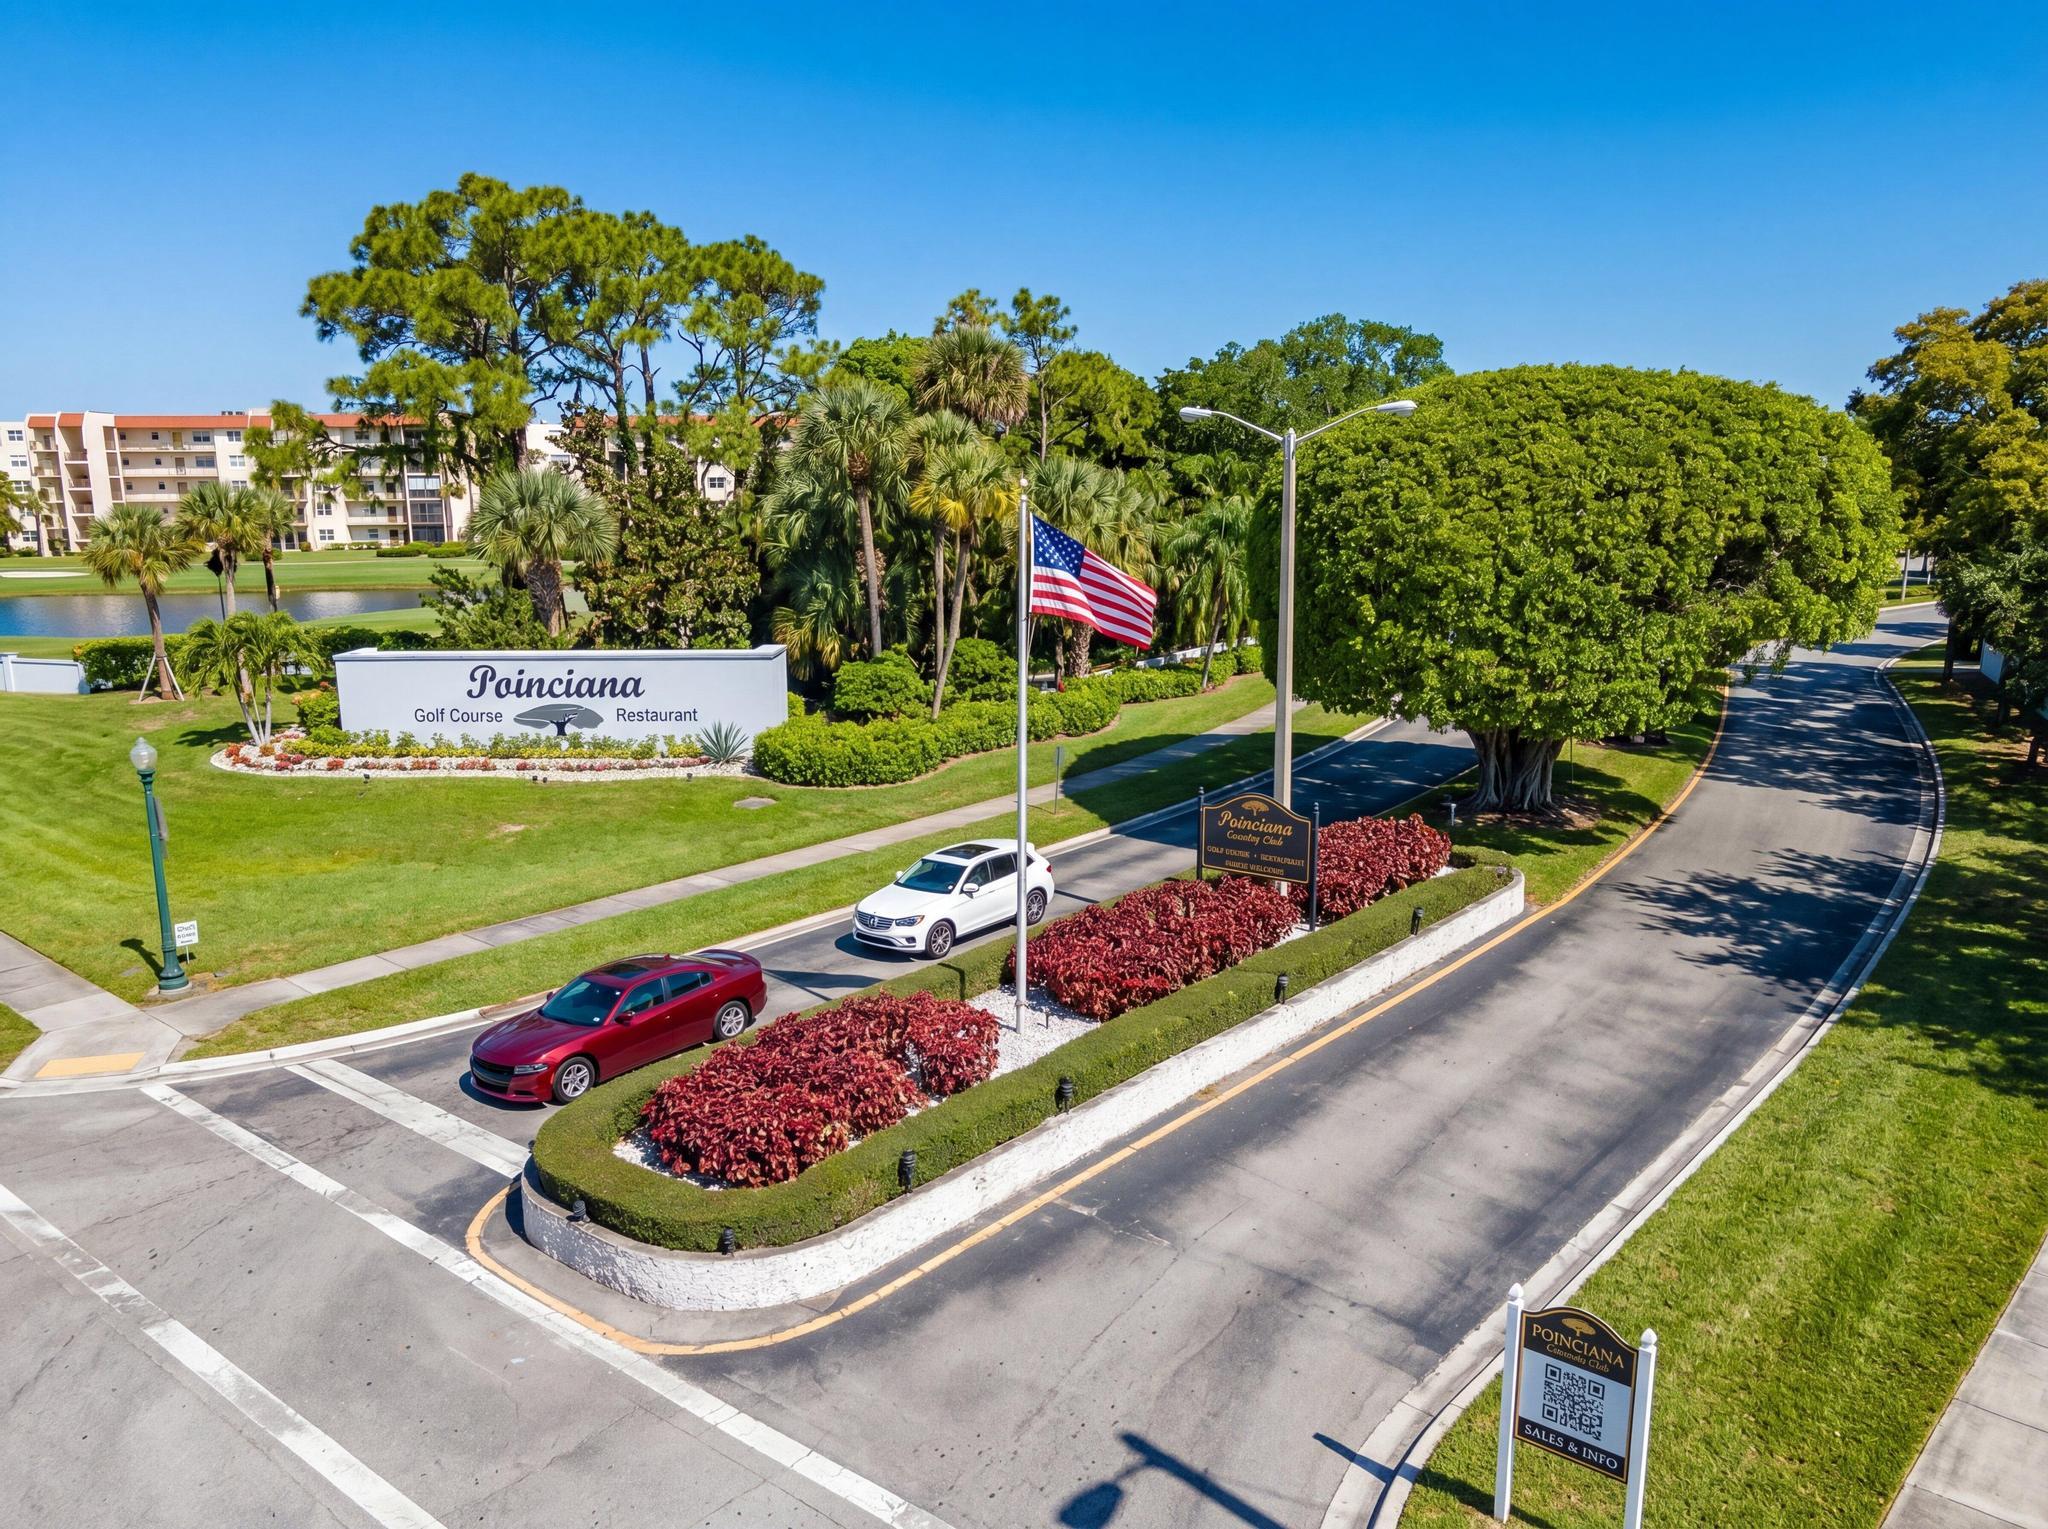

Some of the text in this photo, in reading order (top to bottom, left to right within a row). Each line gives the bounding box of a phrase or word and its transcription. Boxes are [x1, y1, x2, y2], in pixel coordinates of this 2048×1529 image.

[466, 665, 645, 698] Poinciana
[414, 707, 503, 723] Golf Course
[616, 707, 699, 723] Restaurant
[1218, 810, 1293, 836] Poinciana
[1532, 1323, 1625, 1369] POINCIANA
[1524, 1424, 1618, 1470] SALES & INFO
